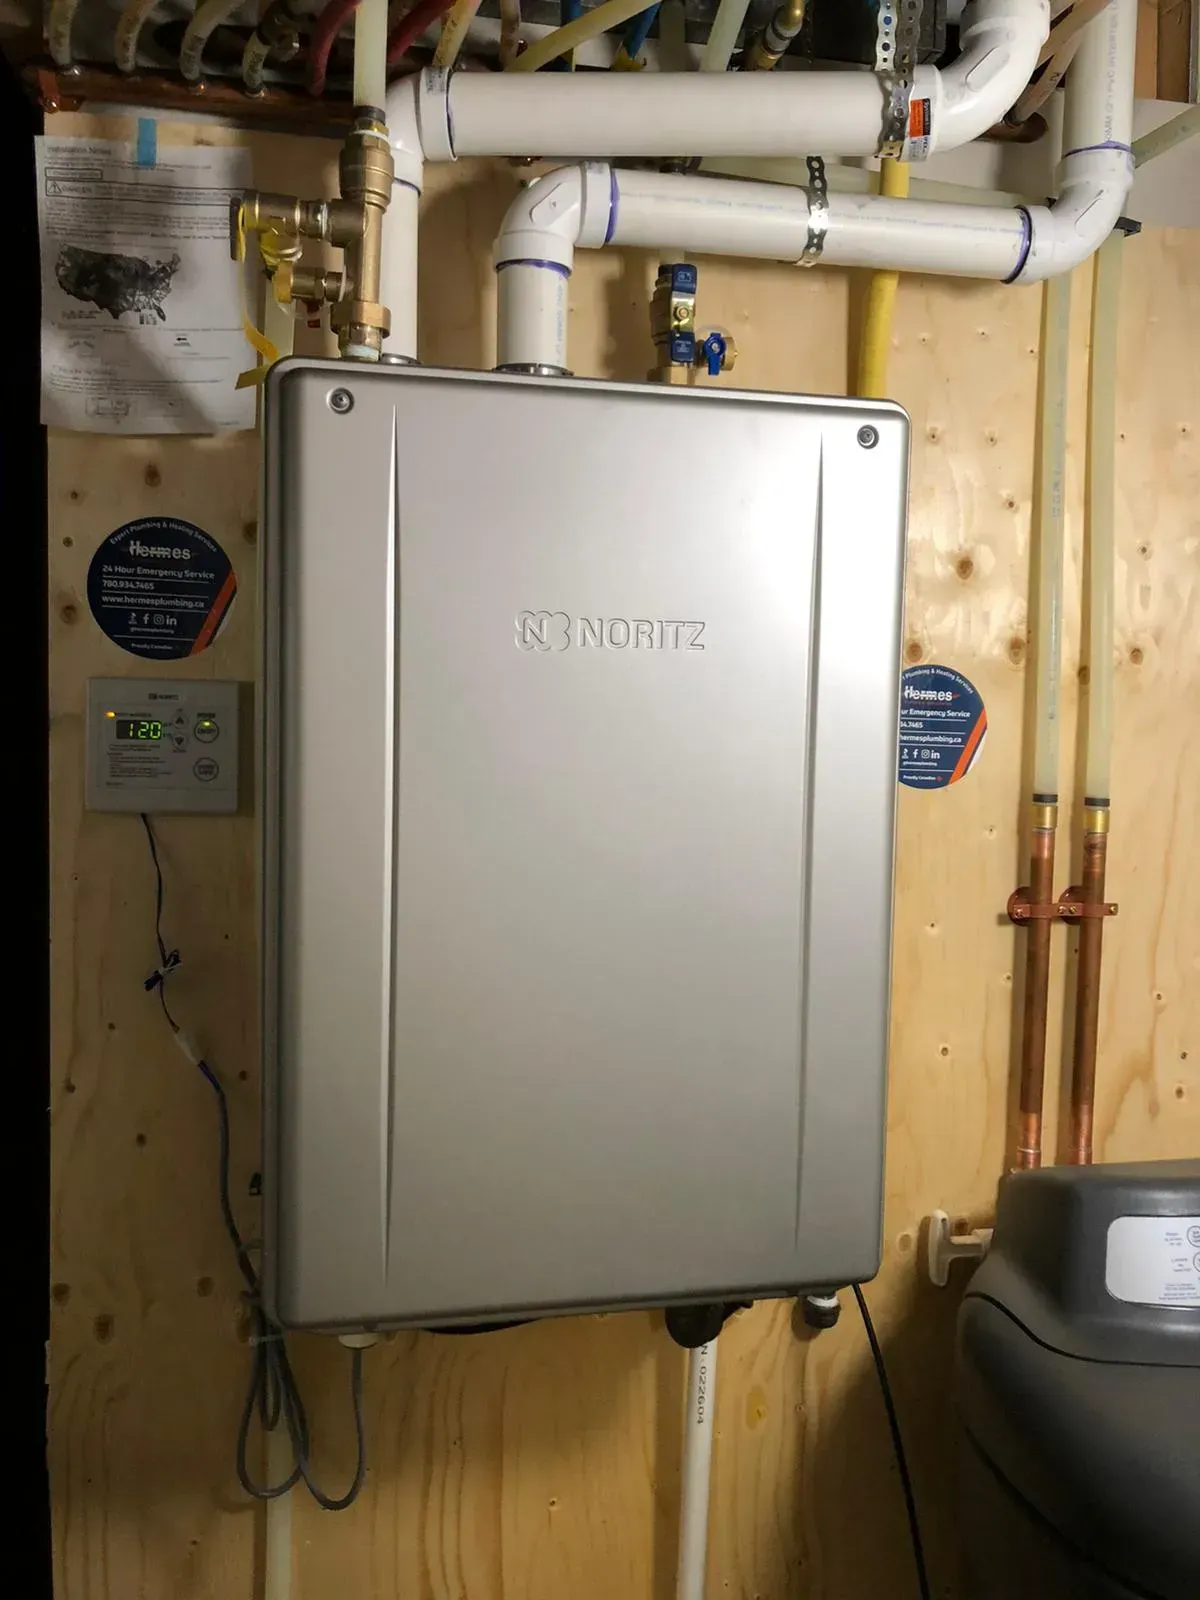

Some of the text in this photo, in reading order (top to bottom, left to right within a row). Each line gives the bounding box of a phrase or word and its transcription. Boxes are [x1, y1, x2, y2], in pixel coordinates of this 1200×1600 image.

[110, 529, 130, 545] Expert
[130, 521, 161, 534] Plumbing
[169, 522, 194, 537] Heating
[129, 540, 191, 559] Hermes
[102, 565, 215, 579] 24 Hour Emergency Service
[102, 580, 155, 590] 780.934.7465
[101, 595, 205, 609] www.hermesplumbing.ca
[577, 616, 706, 651] NORITZ
[905, 669, 930, 680] Plumbing
[935, 669, 956, 681] Heating
[904, 685, 953, 702] Hermes
[909, 709, 946, 717] Emergency
[946, 709, 971, 718] Service
[129, 721, 162, 739] 120
[697, 1366, 707, 1424] 022604
